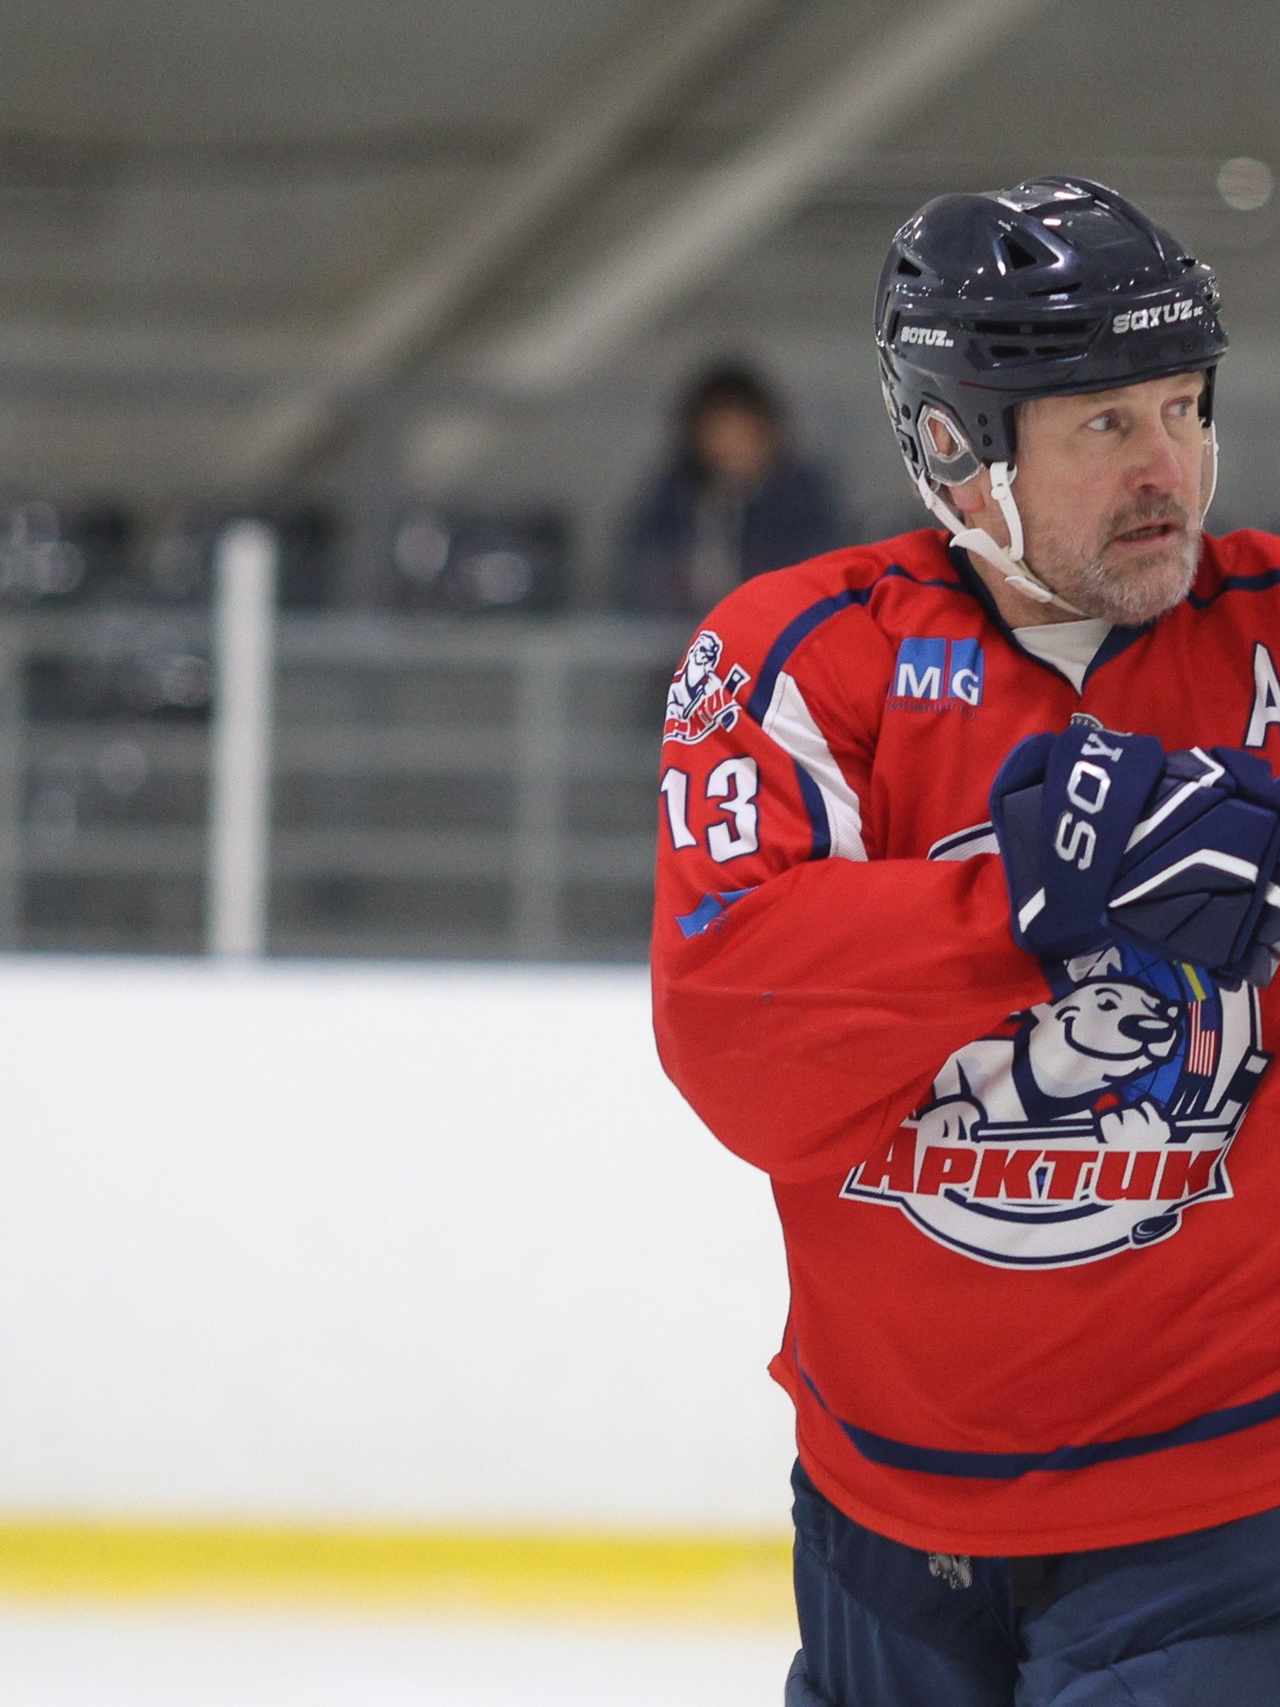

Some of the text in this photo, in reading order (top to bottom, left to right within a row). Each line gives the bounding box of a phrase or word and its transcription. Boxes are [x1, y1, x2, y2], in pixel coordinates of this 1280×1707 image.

[901, 326, 948, 347] SOYUZ
[896, 663, 981, 707] MG
[660, 756, 759, 863] 13
